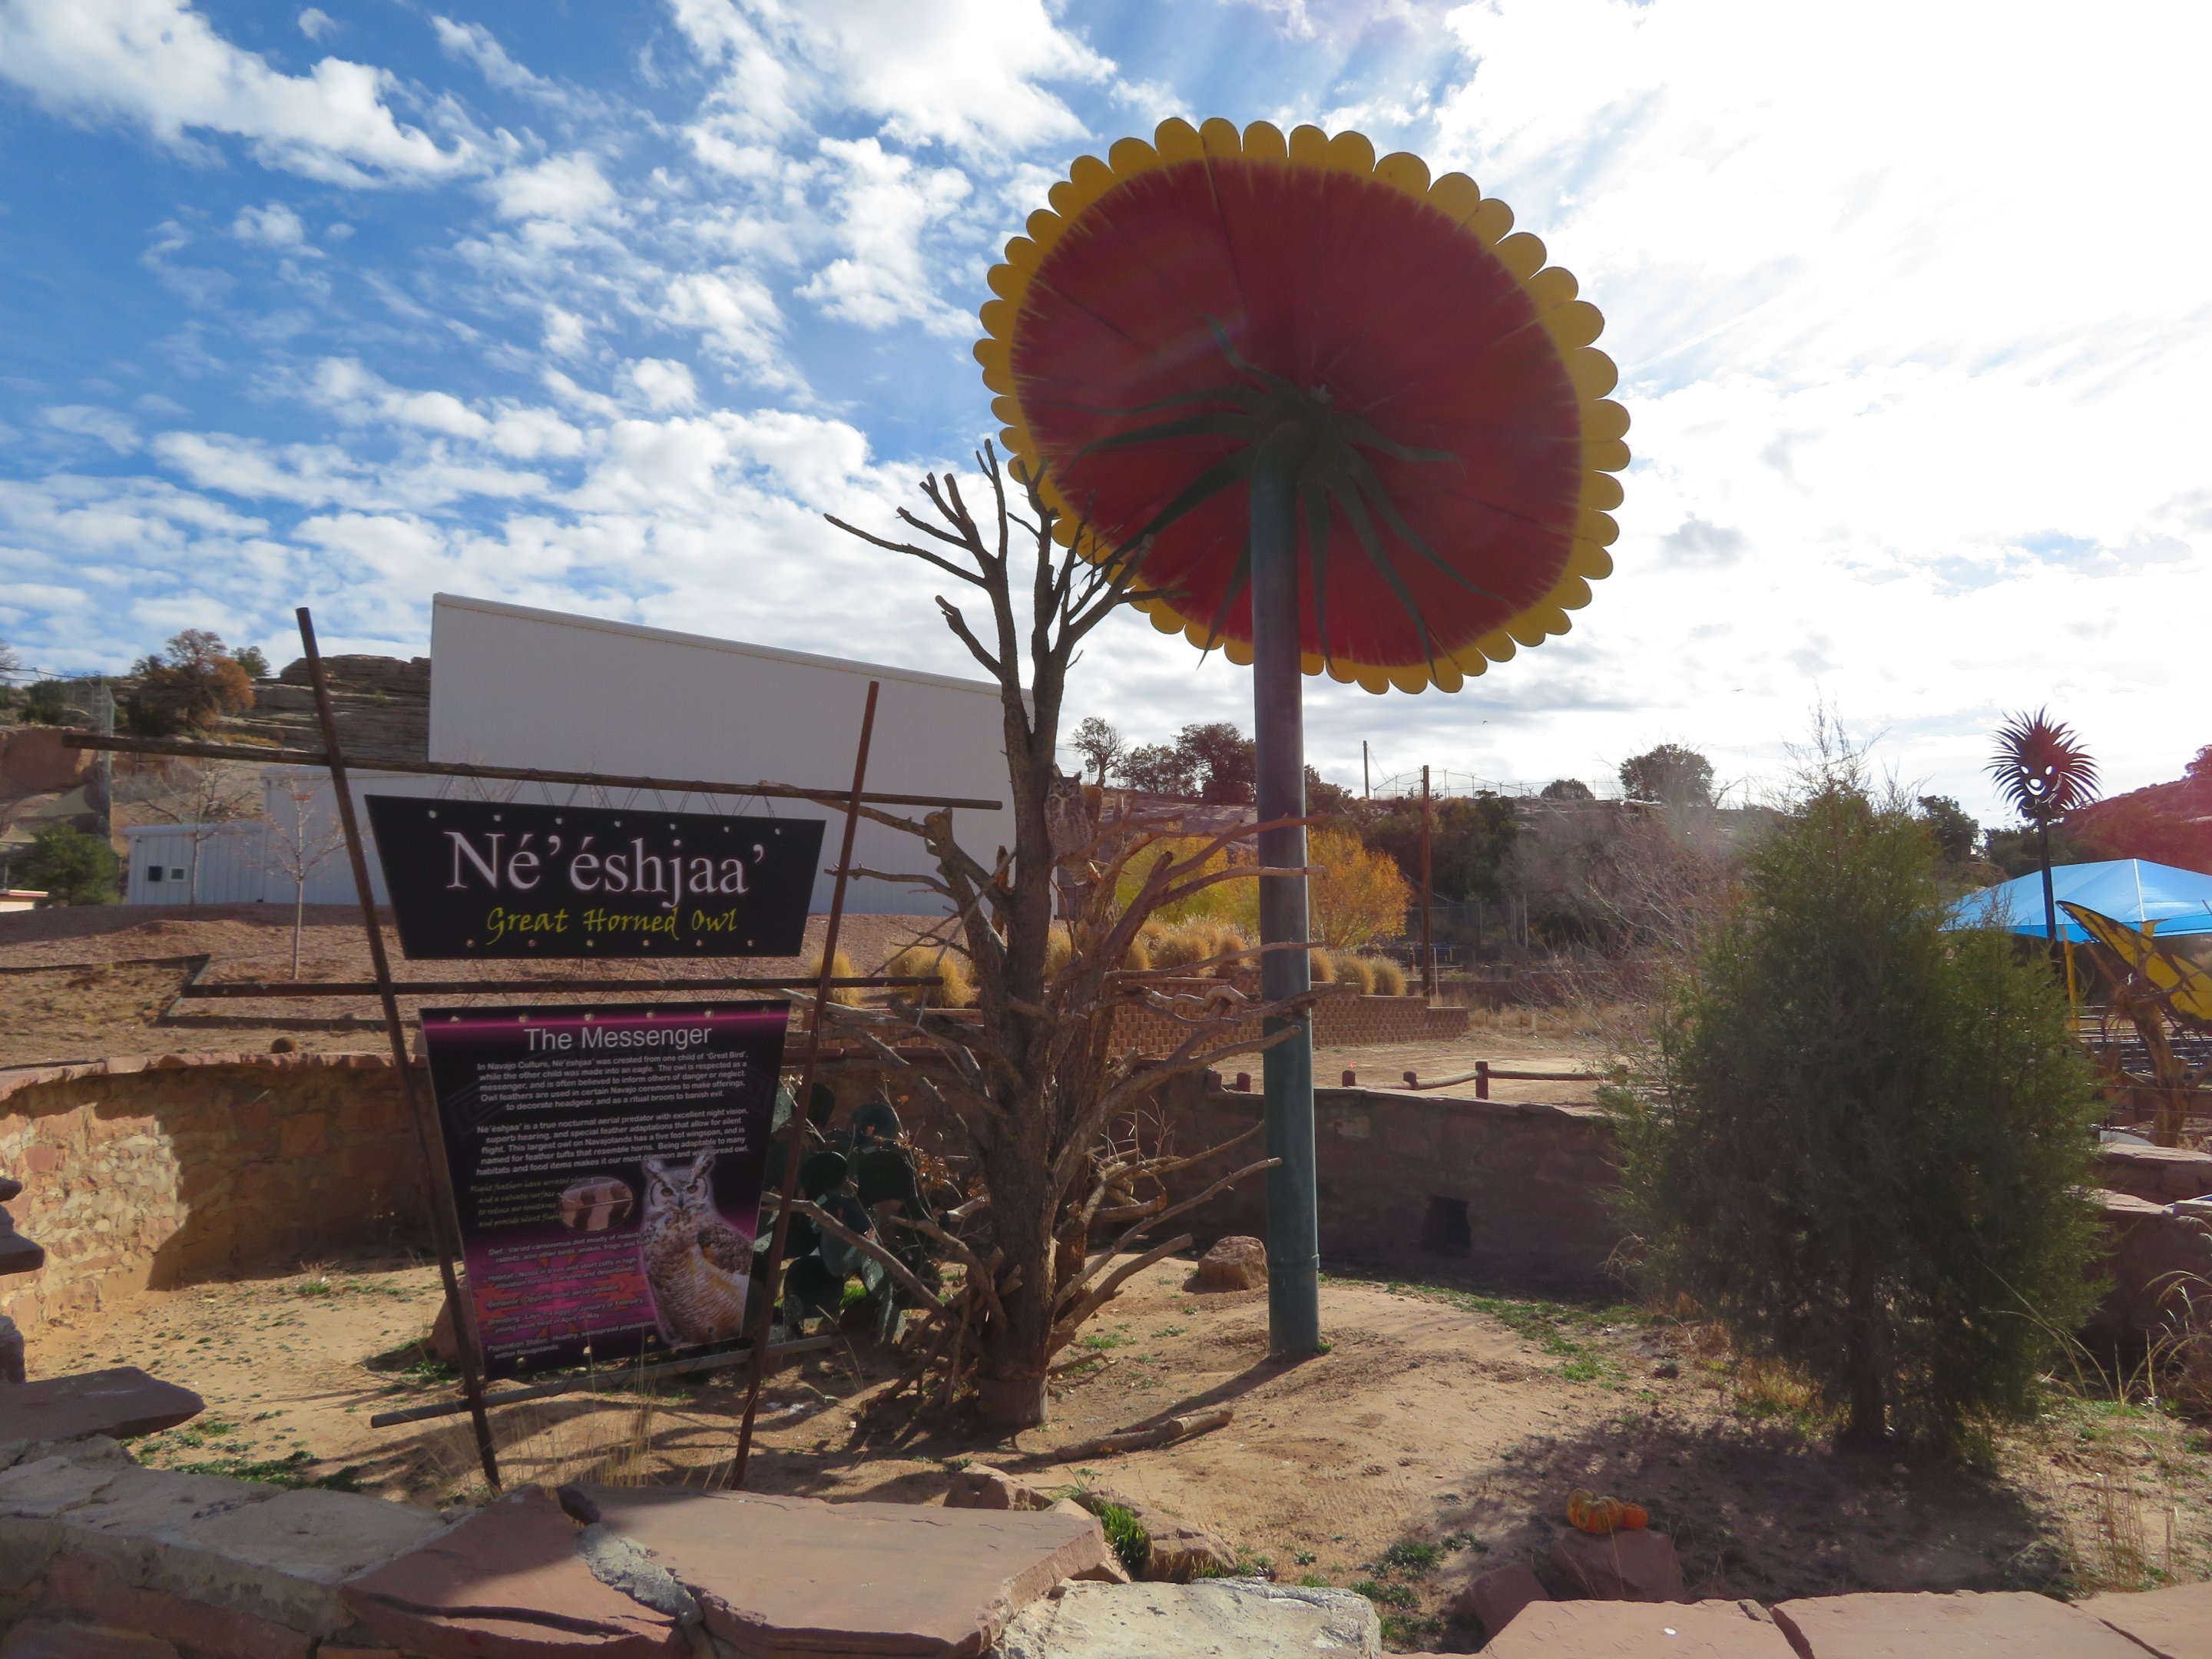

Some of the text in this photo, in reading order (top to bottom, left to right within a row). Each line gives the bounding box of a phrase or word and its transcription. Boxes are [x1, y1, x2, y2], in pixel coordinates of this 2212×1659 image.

[485, 907, 739, 944] Great Horned Owl
[523, 1025, 713, 1054] The Messenger
[487, 1062, 516, 1071] Navajo
[696, 1061, 731, 1070] respected
[578, 1077, 611, 1085] believed
[610, 1086, 637, 1094] Navajo
[638, 1084, 681, 1092] ceremonies
[558, 1118, 596, 1128] nocturnal
[622, 1114, 654, 1124] predator
[673, 1111, 705, 1119] excellent
[707, 1109, 725, 1118] night
[486, 1134, 516, 1144] superb
[570, 1128, 599, 1137] special
[630, 1123, 674, 1132] adaptations
[527, 1141, 556, 1151] largest
[584, 1135, 632, 1145] Navajolands
[481, 1155, 511, 1164] named
[594, 1146, 630, 1154] resemble
[680, 1139, 717, 1148] adaptable
[476, 1166, 511, 1174] habitats
